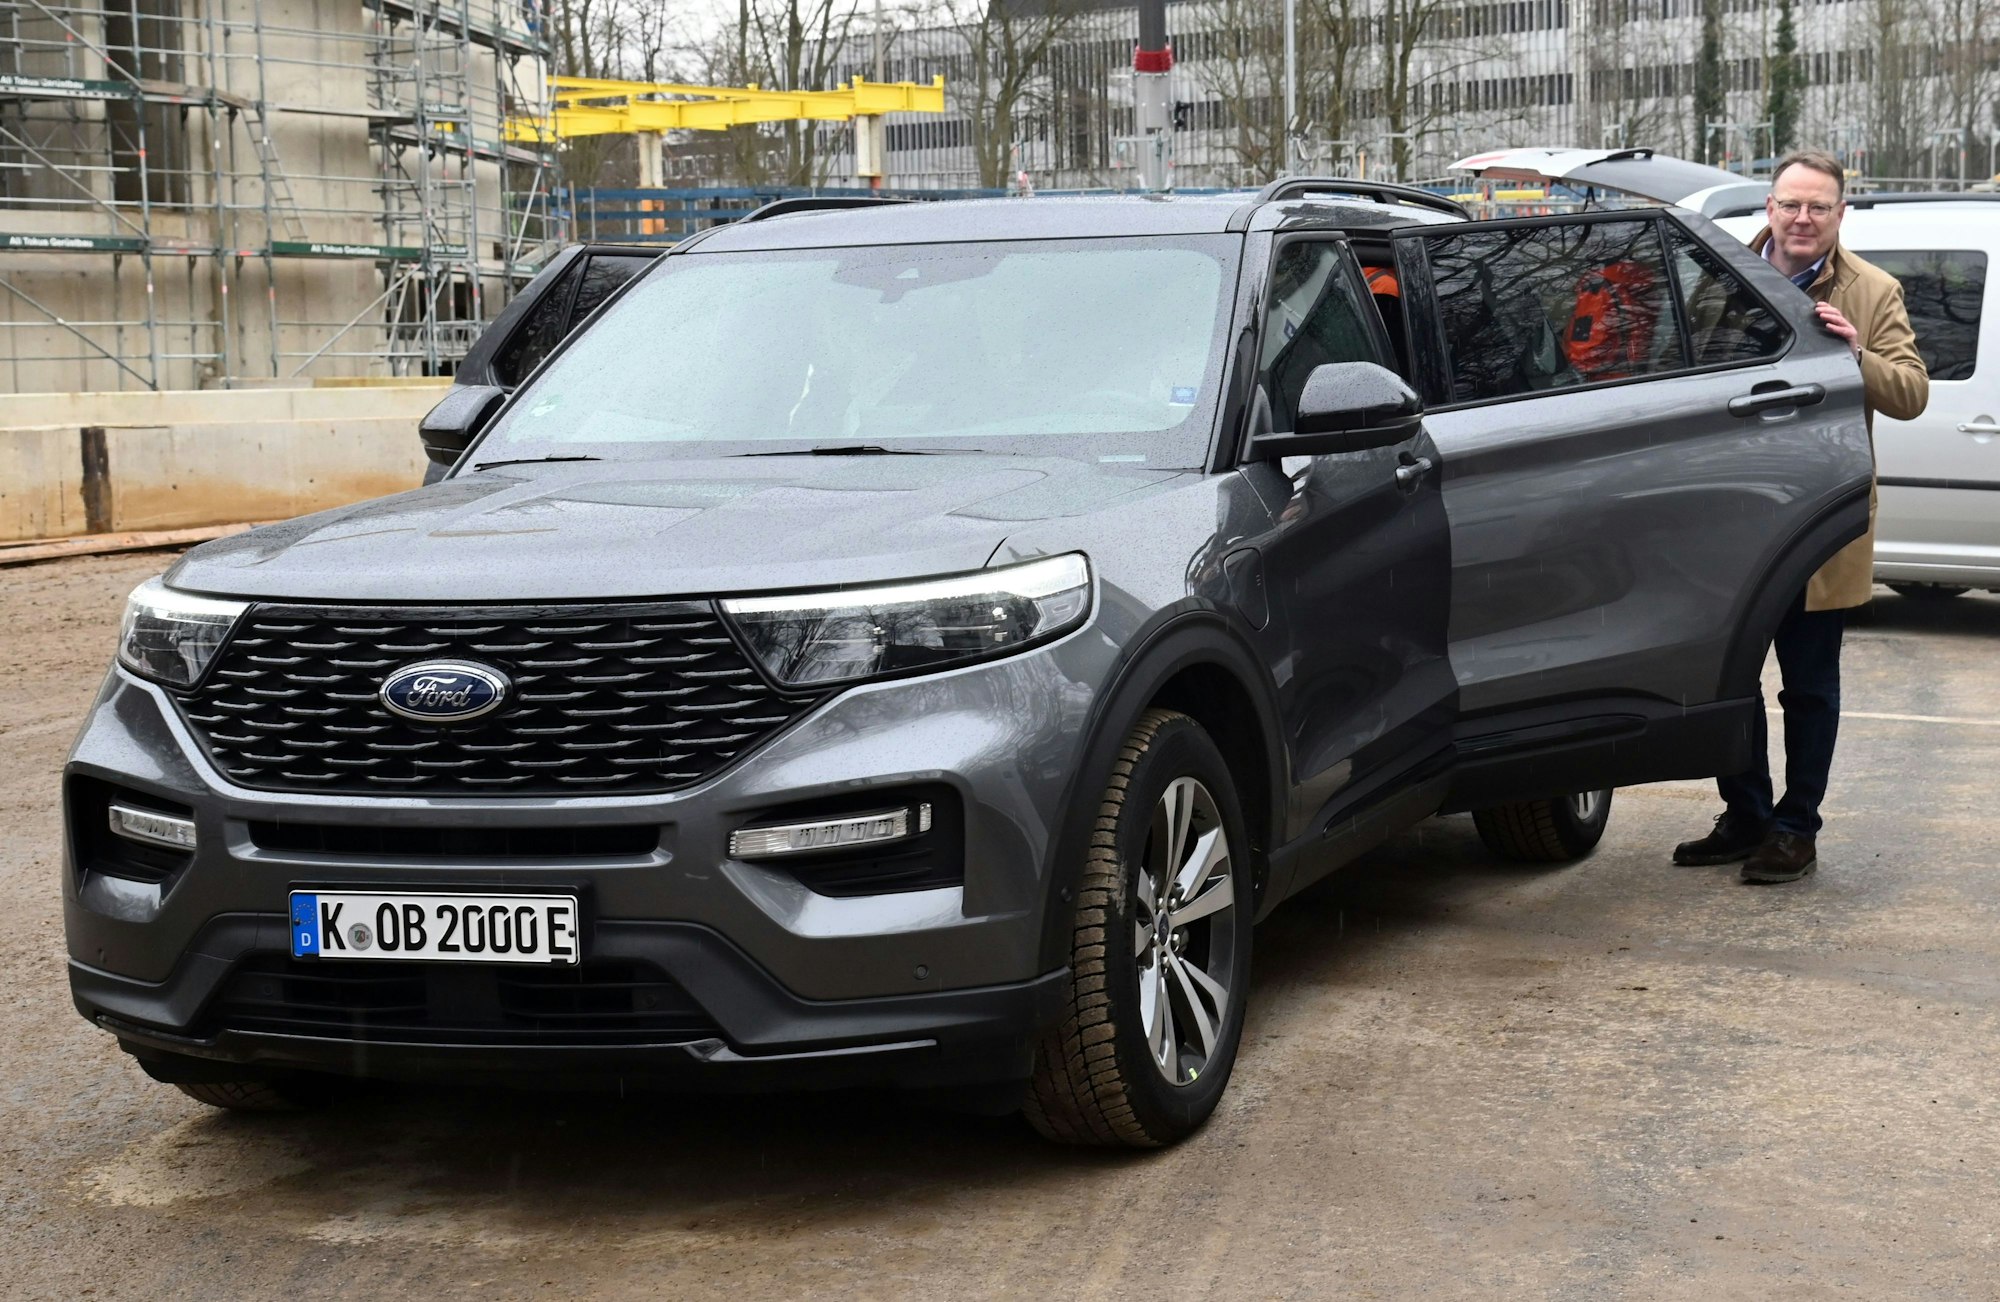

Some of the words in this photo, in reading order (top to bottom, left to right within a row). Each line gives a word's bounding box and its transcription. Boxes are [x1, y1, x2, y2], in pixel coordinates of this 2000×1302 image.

[406, 676, 473, 707] Ford
[301, 932, 312, 947] D
[321, 902, 346, 950] K
